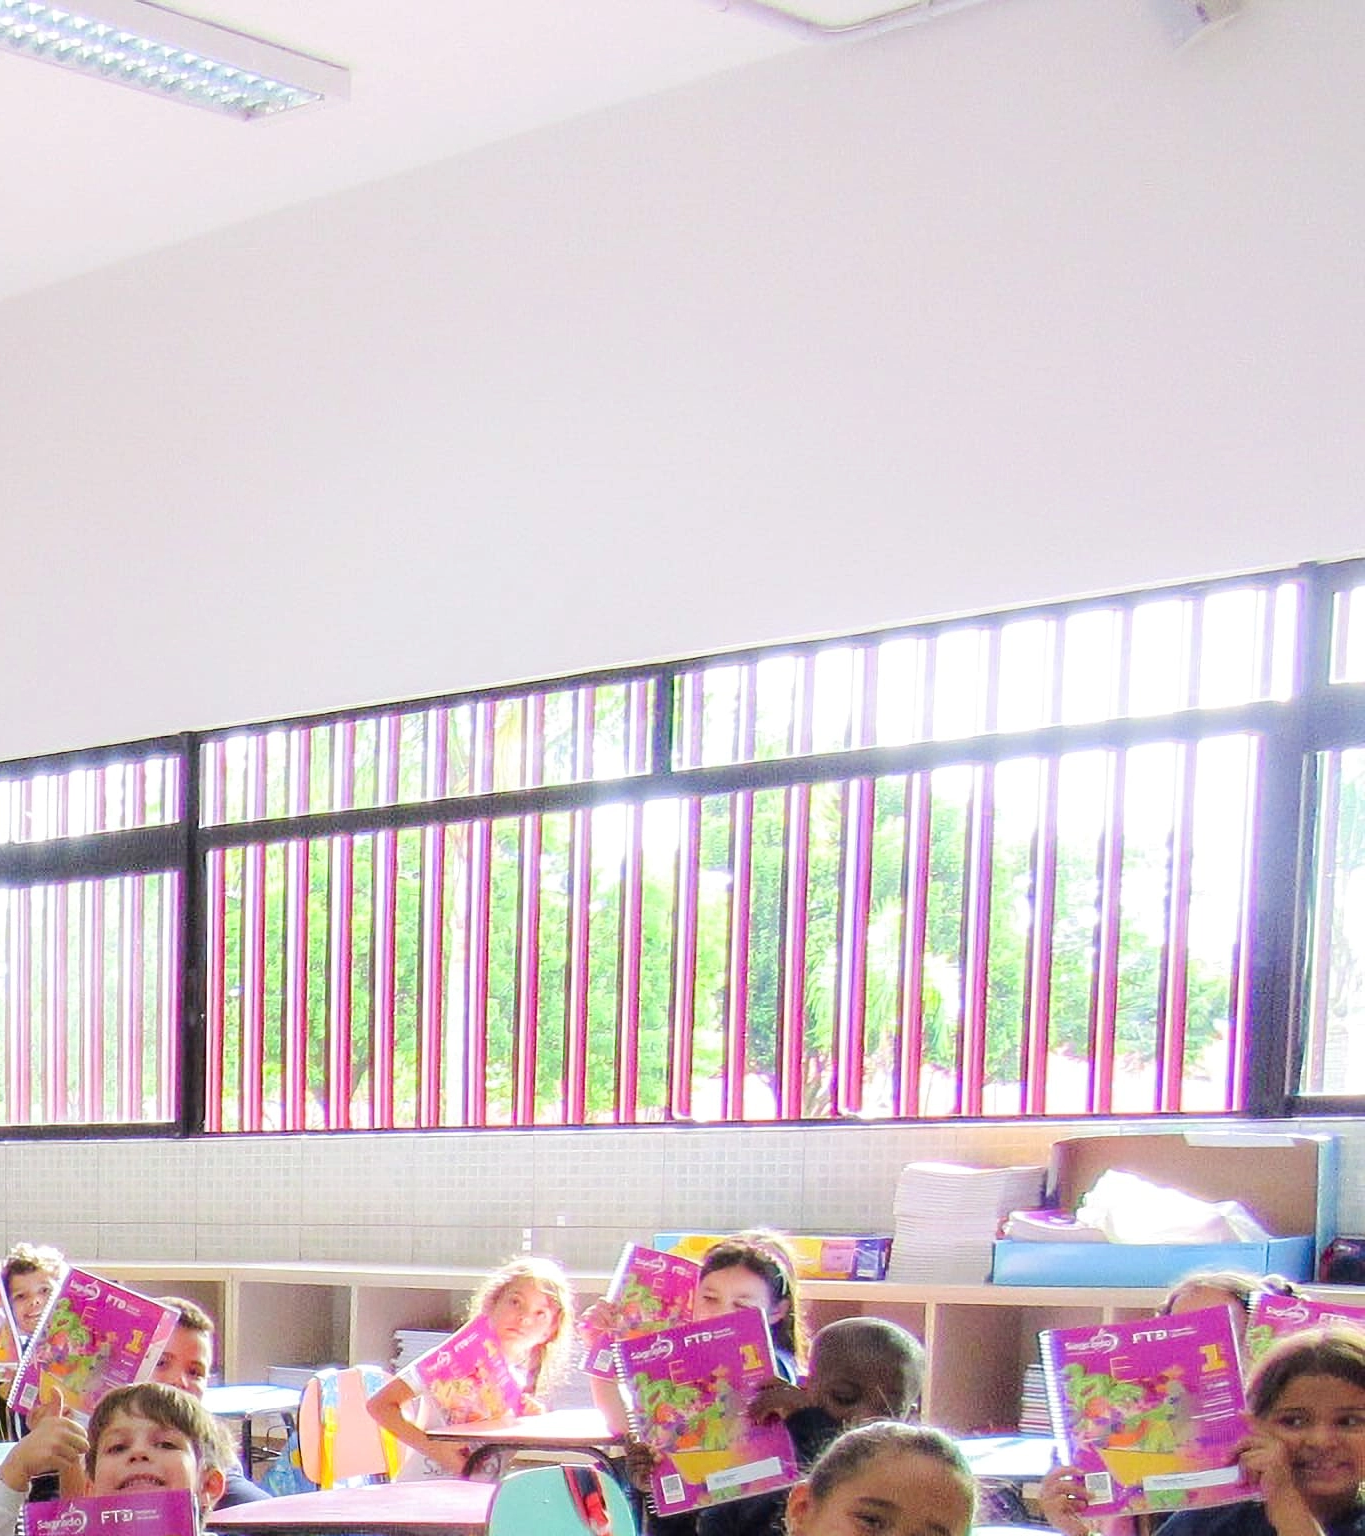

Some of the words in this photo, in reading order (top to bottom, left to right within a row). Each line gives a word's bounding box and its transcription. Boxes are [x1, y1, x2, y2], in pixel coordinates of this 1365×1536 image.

[125, 1330, 144, 1353] 1
[1133, 1330, 1167, 1344] FTD
[740, 1345, 763, 1370] 1
[1199, 1344, 1228, 1372] 1
[101, 1509, 133, 1525] FTD
